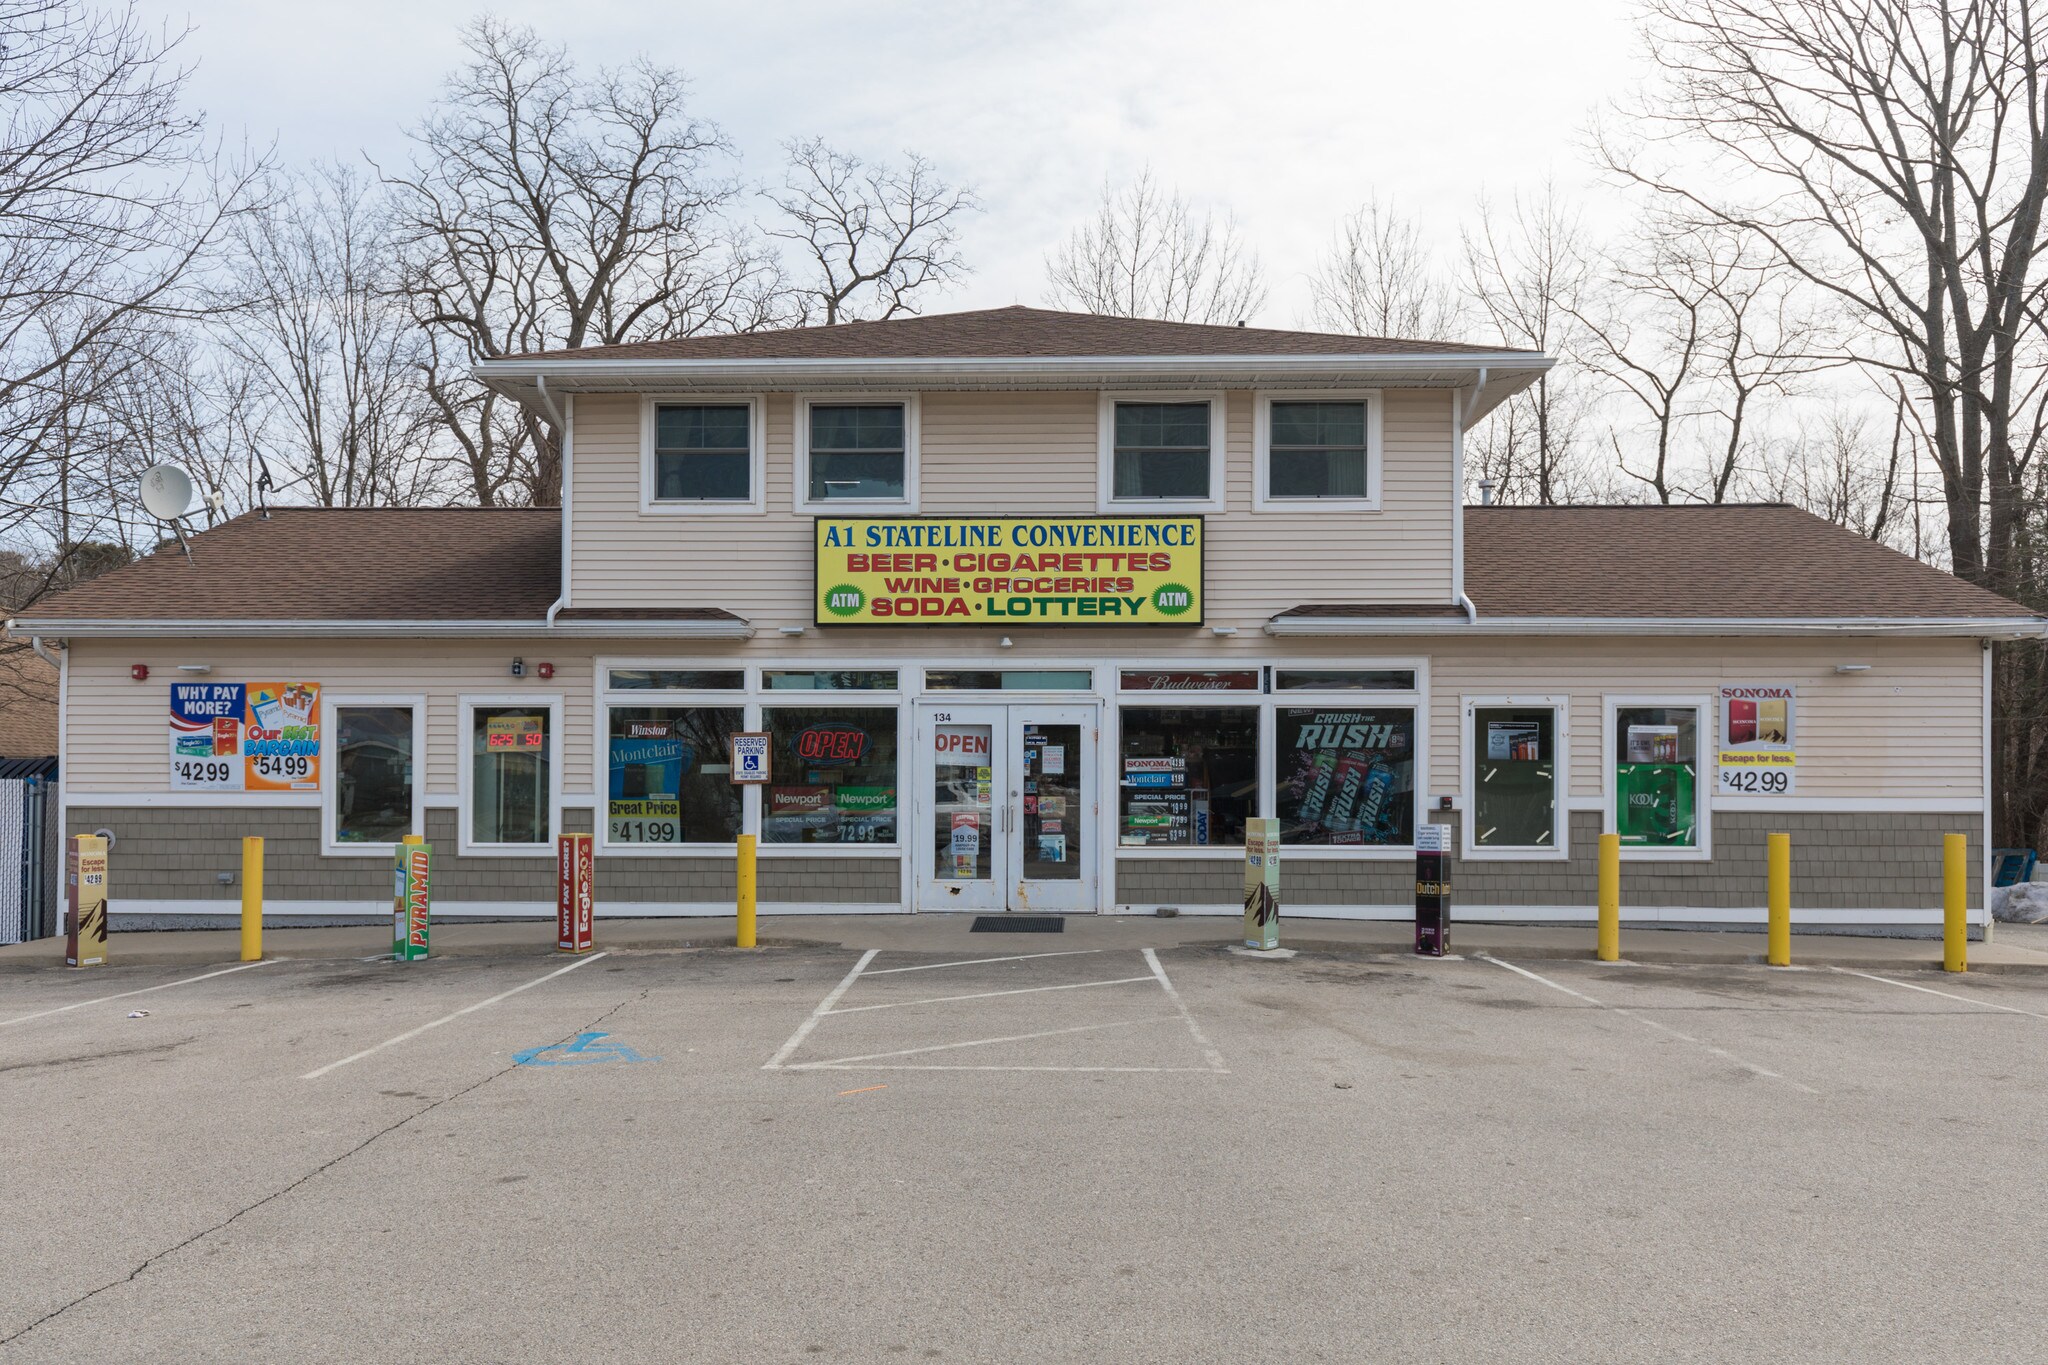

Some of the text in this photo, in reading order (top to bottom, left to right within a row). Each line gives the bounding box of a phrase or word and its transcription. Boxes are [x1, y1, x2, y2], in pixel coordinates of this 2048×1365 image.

[823, 524, 1196, 547] A1 STATELINE CONVENIENCE
[847, 552, 1171, 572] BEER CIGARETTES
[884, 577, 1135, 593] WINE GROCERIES
[831, 593, 859, 607] ATM
[1158, 592, 1187, 606] ATM
[871, 597, 1147, 616] SODA LOTTERY
[1148, 675, 1232, 690] Budweiser
[178, 686, 239, 700] WHY PAY
[1721, 688, 1792, 698] SONOMA
[184, 701, 232, 715] MORE?
[934, 713, 951, 722] 134
[1314, 713, 1361, 724] CRUSH
[248, 725, 317, 740] Our BEST
[631, 725, 667, 736] Winston
[1295, 724, 1394, 750] RUSH
[490, 734, 513, 746] 625
[526, 733, 542, 746] 50
[734, 738, 767, 747] RESERVED
[800, 730, 864, 759] OPEN
[935, 733, 988, 753] OPEN
[244, 740, 320, 757] BARGAIN
[612, 743, 678, 764] Montclair
[737, 746, 765, 755] PARKING
[1722, 754, 1793, 764] Escape for less.
[175, 761, 229, 783] $42.99
[253, 757, 308, 777] $54.99
[1126, 774, 1166, 783] Montclair
[1722, 771, 1788, 793] $42.99
[1309, 762, 1334, 813] RUSH
[1334, 766, 1362, 823] RUSH
[775, 794, 821, 805] Newport
[840, 794, 888, 805] Newport
[1361, 777, 1385, 827] RUSH
[1629, 793, 1654, 805] KOOL
[610, 801, 677, 815] Great Price
[612, 821, 675, 843] $41.99
[1248, 838, 1264, 847] Escape
[81, 865, 90, 873] for
[82, 858, 105, 866] Escape
[579, 843, 591, 933] Eagle20's
[1416, 882, 1440, 895] Dutch
[409, 850, 429, 949] PYRAMID
